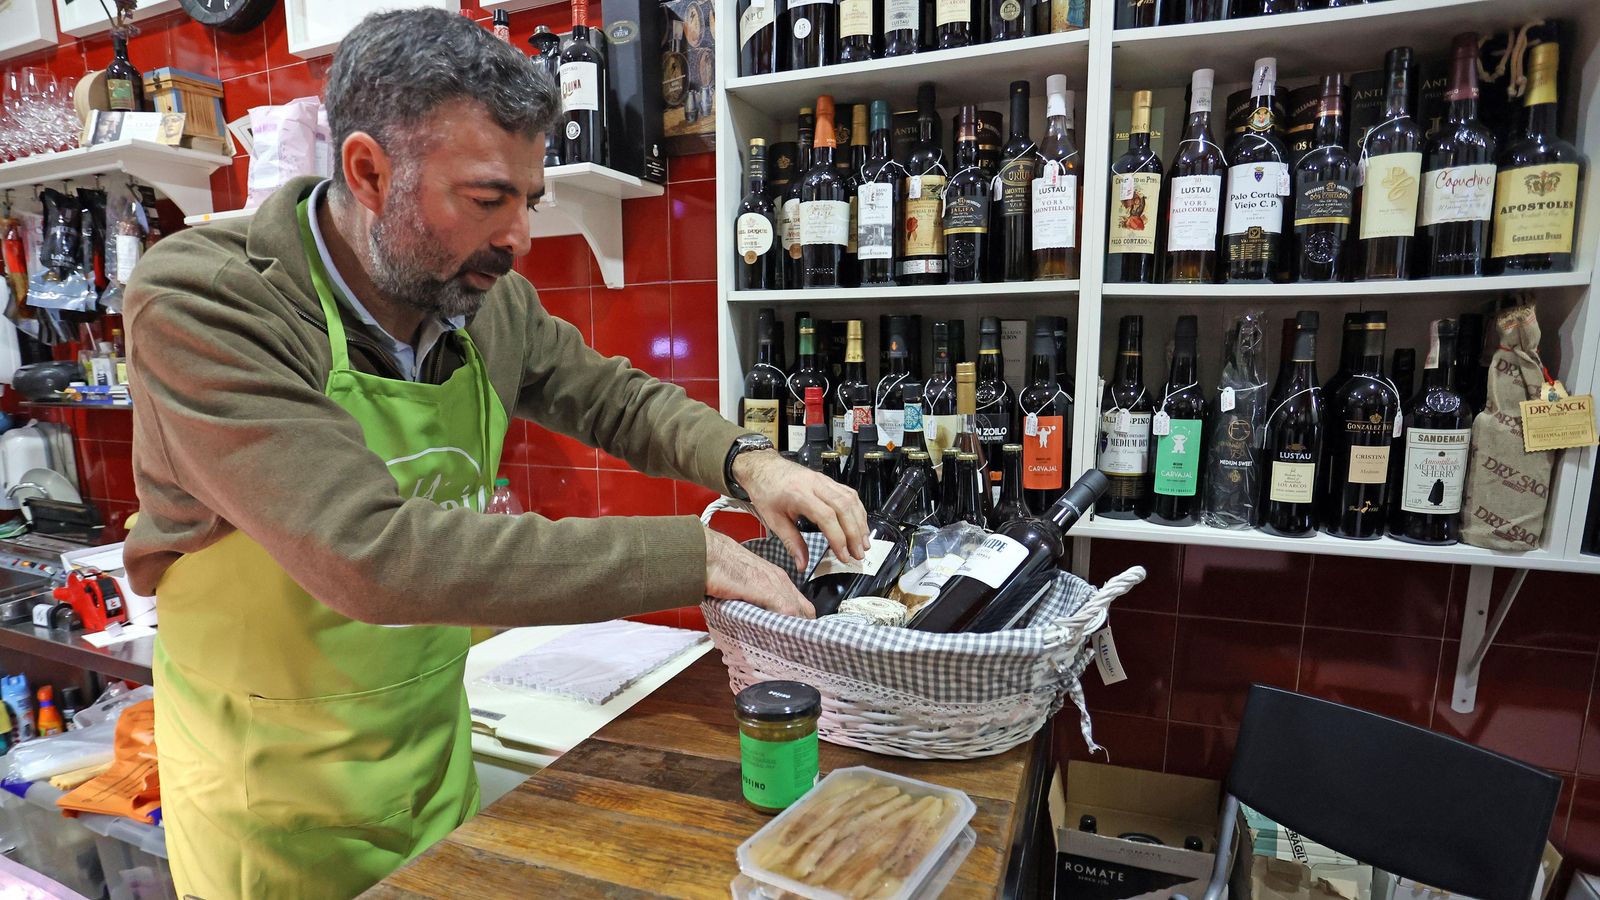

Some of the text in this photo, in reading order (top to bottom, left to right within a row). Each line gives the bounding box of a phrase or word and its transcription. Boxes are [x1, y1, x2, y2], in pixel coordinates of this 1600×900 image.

[1435, 170, 1491, 194] Capuchino
[1039, 186, 1066, 194] LUSTAU
[1500, 201, 1574, 215] APOSTOLES
[1530, 402, 1586, 414] DRY SACK
[983, 427, 1008, 435] ZOILO
[1347, 422, 1381, 431] GONZALEZ
[1111, 438, 1137, 447] MEDIUM
[1418, 434, 1465, 443] SANDEMAN
[1280, 452, 1312, 460] LUSTAU
[1482, 456, 1521, 479] DRY
[1160, 471, 1192, 479] CARVAJAL
[1421, 469, 1456, 478] SHERRY
[1473, 505, 1511, 529] DRY
[1064, 862, 1125, 882] ROMATE
